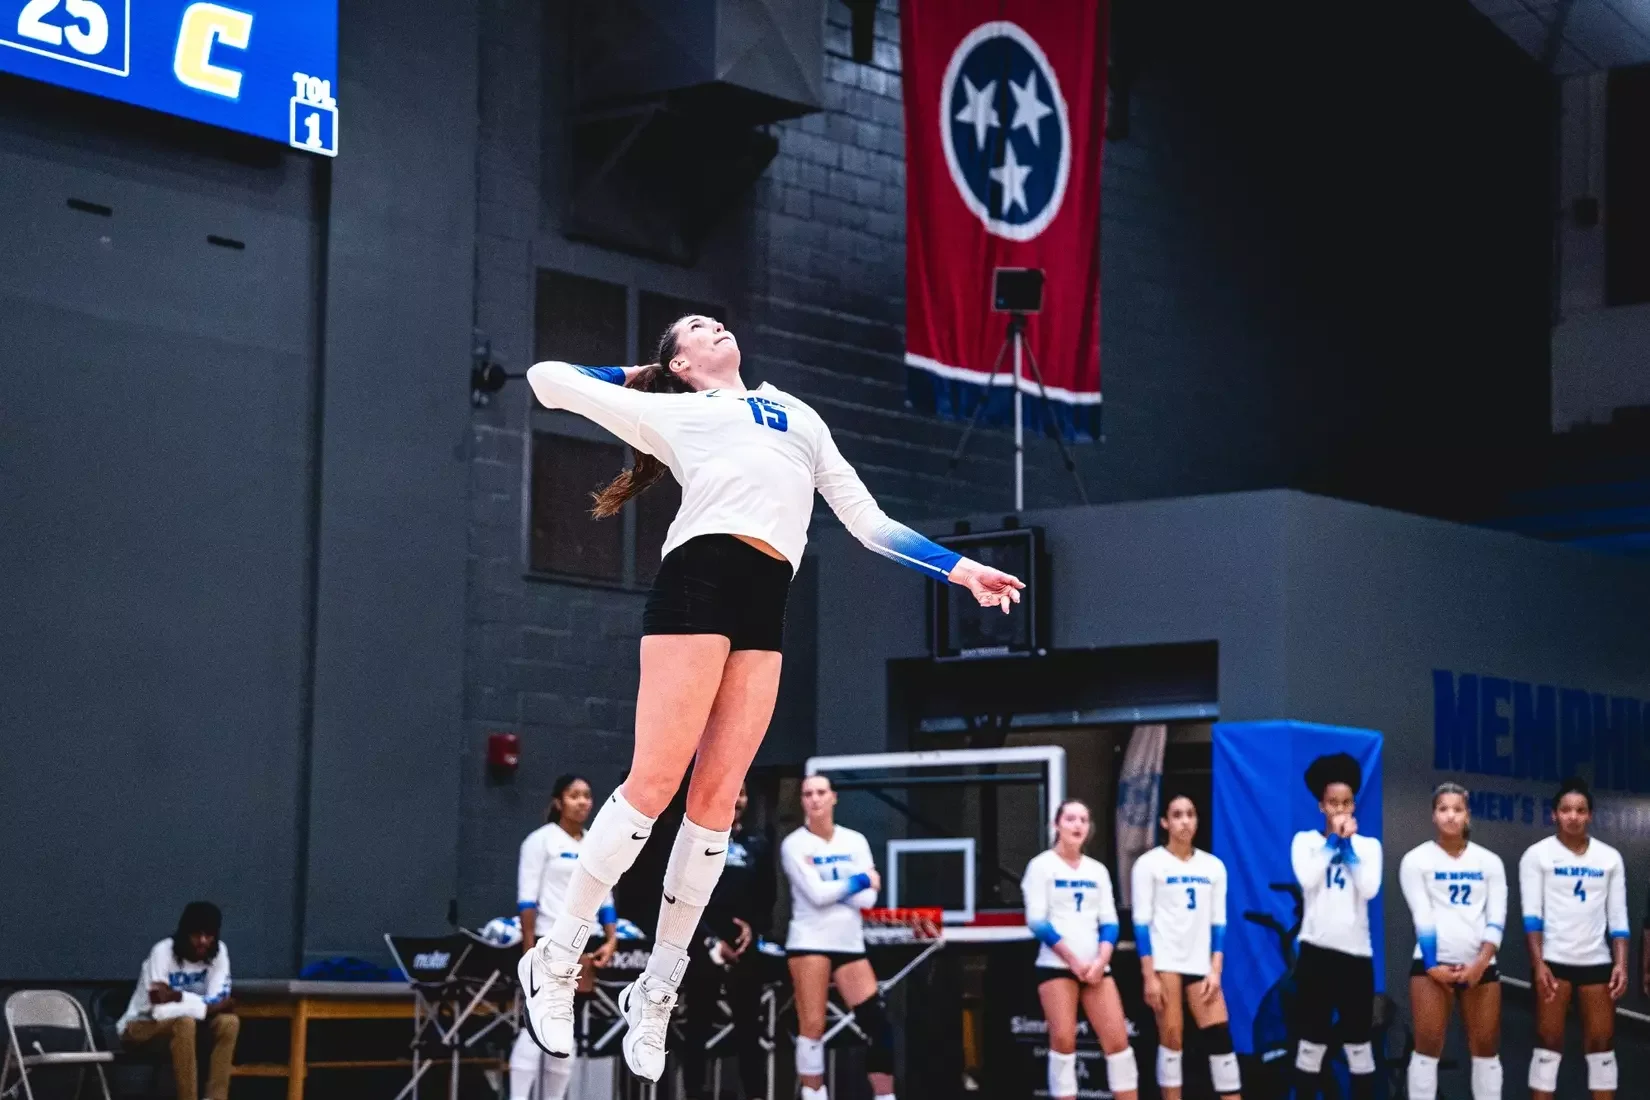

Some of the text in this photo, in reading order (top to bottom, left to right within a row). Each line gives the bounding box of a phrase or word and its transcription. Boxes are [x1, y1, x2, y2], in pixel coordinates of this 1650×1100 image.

[17, 0, 109, 55] 25
[174, 2, 253, 99] C
[292, 71, 337, 107] TOL
[304, 112, 323, 148] 1
[747, 399, 788, 432] 15
[1433, 669, 1650, 795] MEMPHI
[1326, 866, 1345, 890] 14
[1574, 880, 1586, 902] 4
[1073, 892, 1084, 912] 7
[1186, 888, 1196, 910] 3
[1448, 884, 1471, 906] 22
